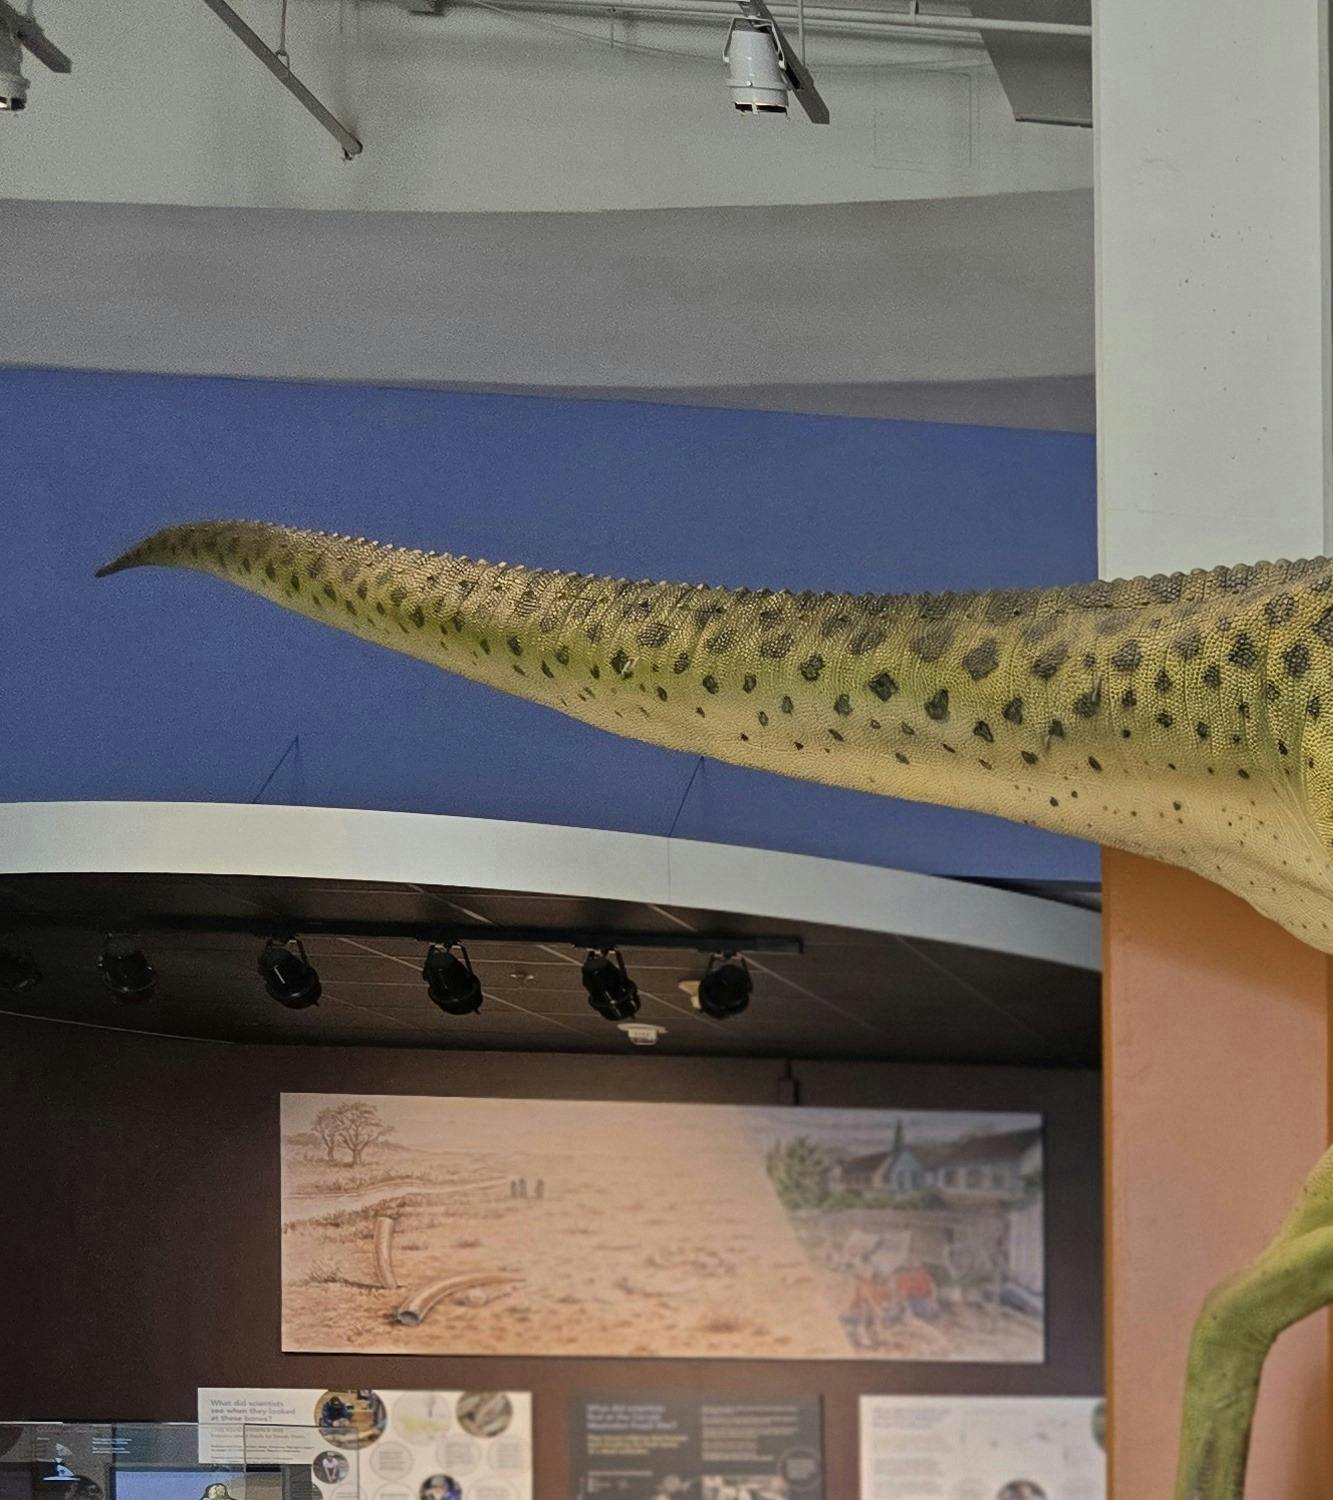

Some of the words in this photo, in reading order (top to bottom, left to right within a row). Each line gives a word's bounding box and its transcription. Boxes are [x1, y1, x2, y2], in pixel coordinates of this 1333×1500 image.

[210, 1399, 232, 1407] What
[234, 1399, 247, 1407] did
[249, 1408, 267, 1416] they
